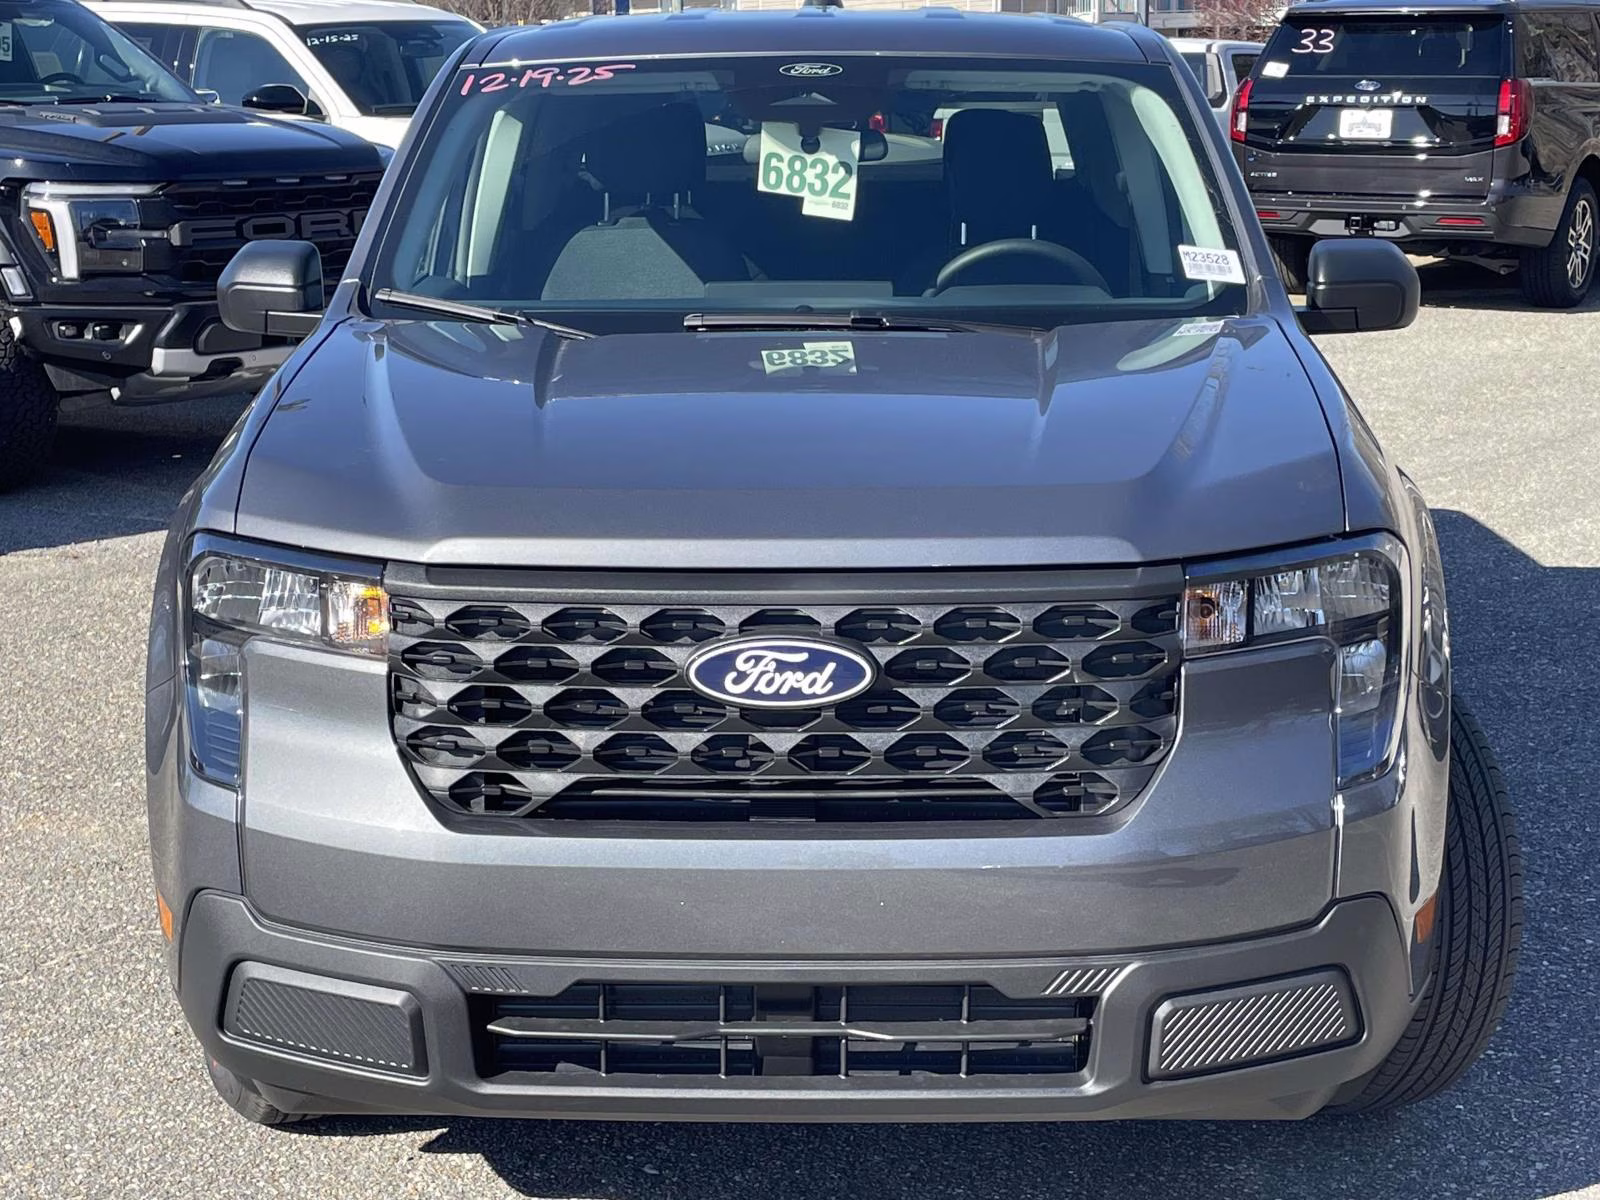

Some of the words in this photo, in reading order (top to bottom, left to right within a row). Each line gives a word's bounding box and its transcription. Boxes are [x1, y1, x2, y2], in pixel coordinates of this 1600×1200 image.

[1291, 28, 1335, 53] 33
[790, 64, 831, 74] Ford
[1306, 95, 1427, 103] EXPEDITION
[762, 152, 853, 200] 6832
[1183, 251, 1230, 265] M23528
[724, 650, 837, 695] Ford
